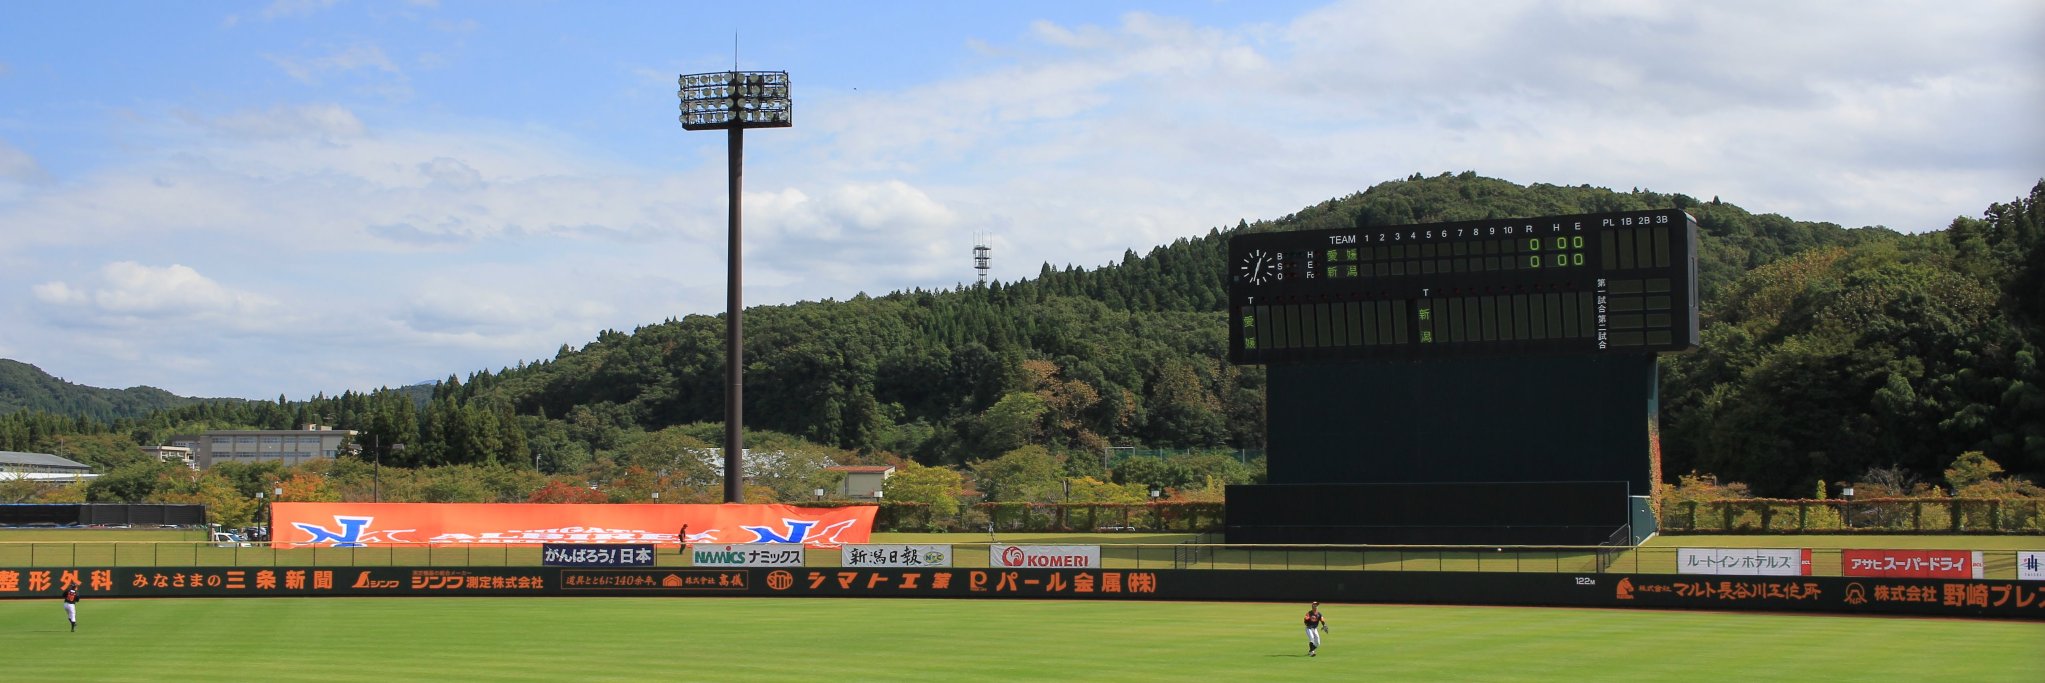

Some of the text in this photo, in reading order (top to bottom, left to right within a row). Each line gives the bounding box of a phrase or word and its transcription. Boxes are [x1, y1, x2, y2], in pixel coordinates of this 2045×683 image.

[1602, 215, 1668, 227] PL 1B 2B 3B
[1329, 235, 1356, 245] TEAM
[1426, 231, 1432, 239] 5
[1441, 230, 1447, 238] 6
[1457, 229, 1463, 237] 7
[1473, 228, 1479, 236] 8
[1489, 227, 1495, 235] 9
[1503, 226, 1513, 234] 10
[1574, 222, 1581, 230] E
[1530, 238, 1539, 250] 0
[1557, 237, 1567, 249] 0
[1573, 236, 1583, 248] 0
[1277, 252, 1283, 260] B
[1307, 251, 1314, 259] H
[1277, 262, 1283, 270] S
[1307, 261, 1313, 269] E
[1327, 253, 1583, 278] 新潟 0 0 0
[1422, 288, 1429, 297] T
[1597, 278, 1607, 313] 第一試合
[1248, 296, 1254, 304] T
[1419, 308, 1432, 344] 新潟
[1598, 314, 1607, 350] 第二試合
[694, 546, 801, 564] NAMICS ナミックス
[849, 546, 922, 566] 新潟日報
[1027, 555, 1089, 567] KOMERI
[1851, 557, 1965, 572] アサヒスーパードライ
[370, 580, 400, 589] シンワ
[807, 571, 953, 590] シマト工業
[1874, 585, 1938, 602] 株式会社
